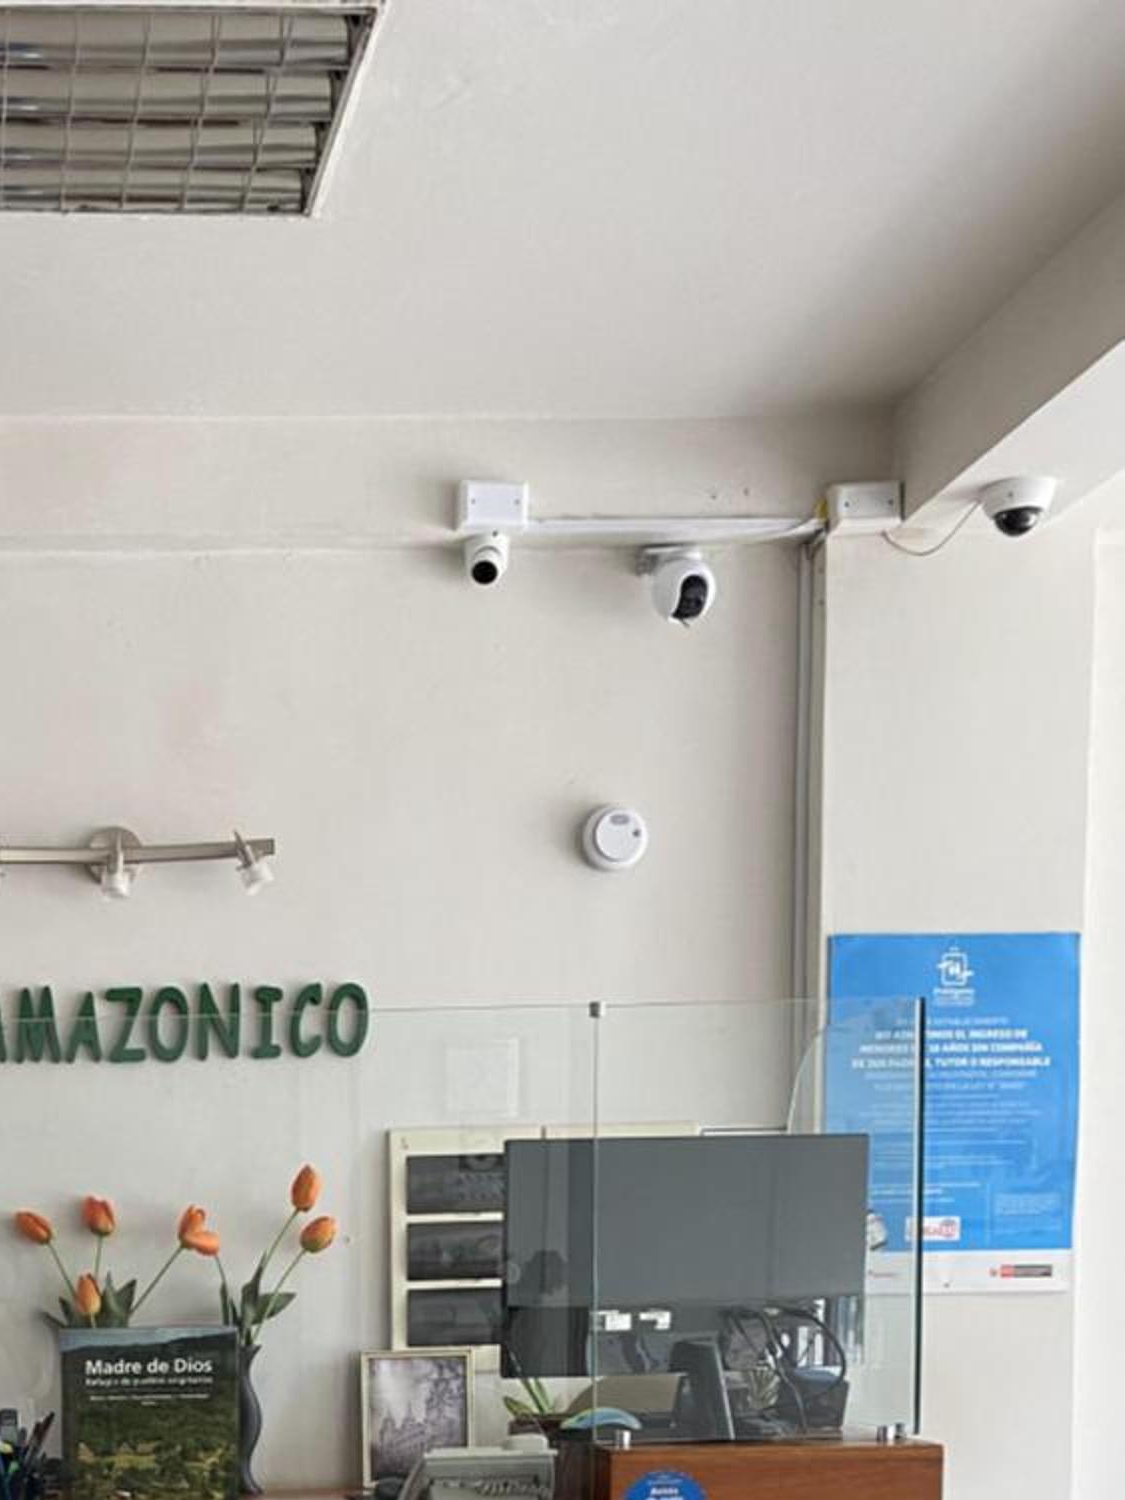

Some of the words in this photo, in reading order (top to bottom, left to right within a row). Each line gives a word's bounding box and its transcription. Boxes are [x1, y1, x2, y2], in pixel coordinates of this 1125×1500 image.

[85, 1358, 142, 1375] Madre
[146, 1356, 170, 1374] de
[173, 1356, 213, 1374] Dios
